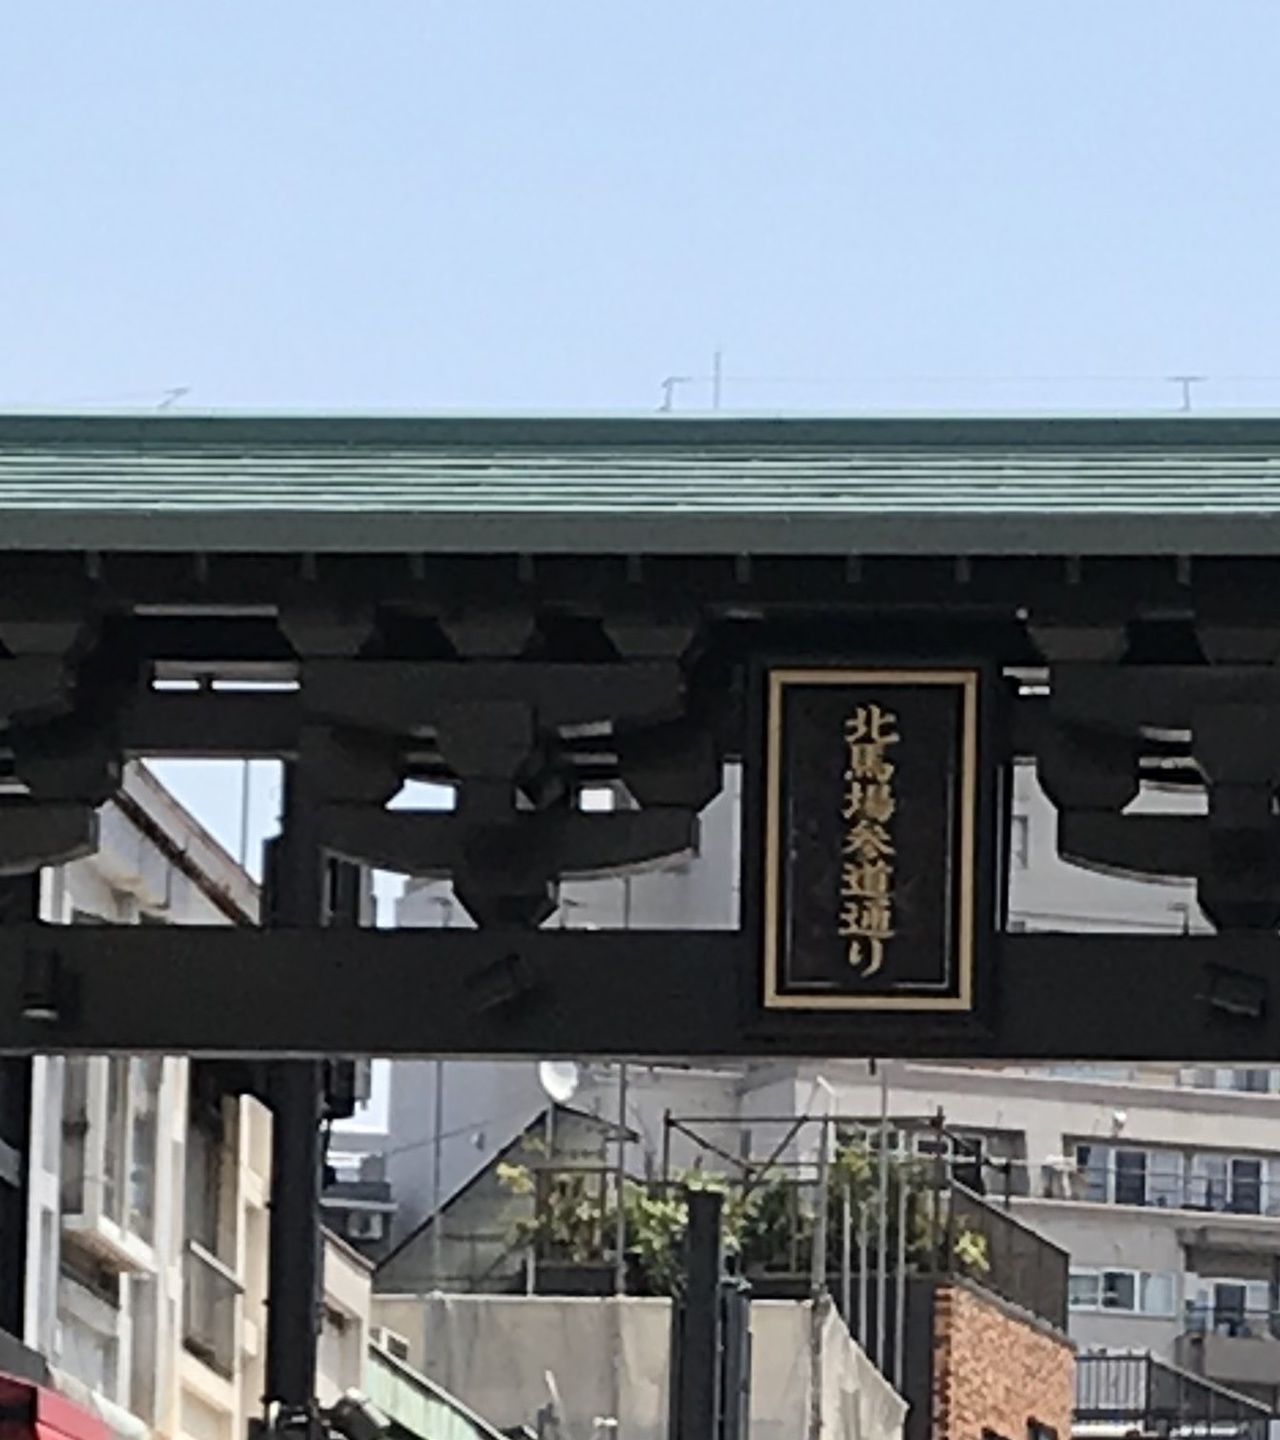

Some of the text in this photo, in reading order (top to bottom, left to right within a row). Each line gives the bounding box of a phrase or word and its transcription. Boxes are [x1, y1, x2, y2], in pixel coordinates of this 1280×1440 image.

[839, 704, 900, 978] 北馬場参道通り
